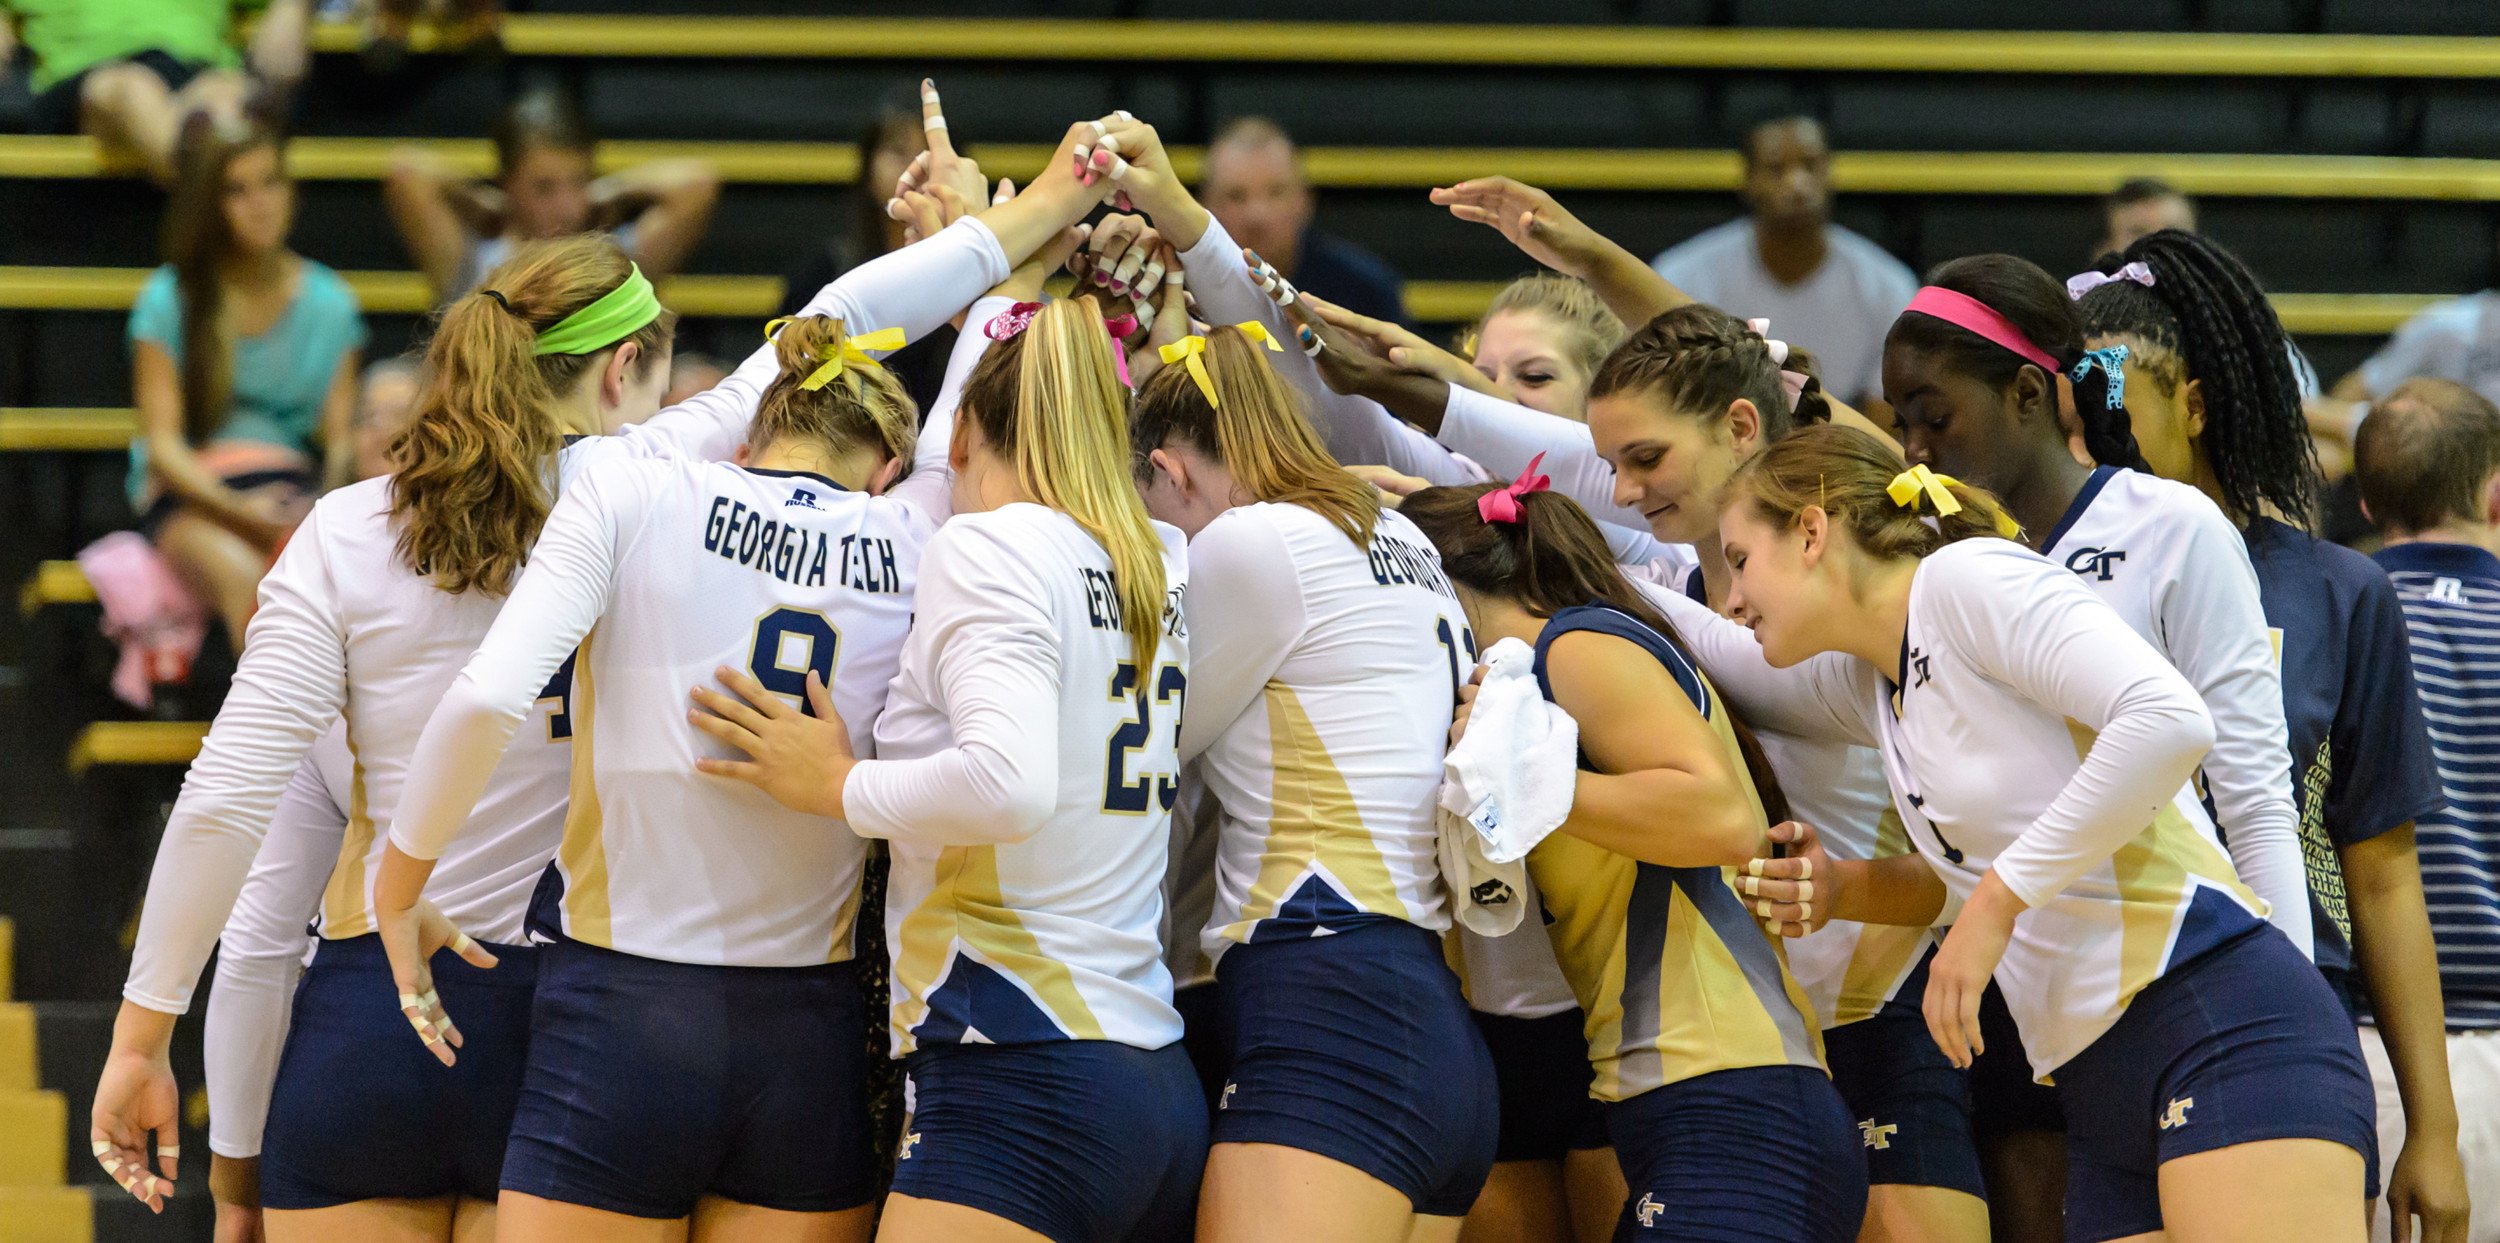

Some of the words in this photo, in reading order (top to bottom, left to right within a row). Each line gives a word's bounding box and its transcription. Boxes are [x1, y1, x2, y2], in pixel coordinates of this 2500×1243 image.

[704, 496, 828, 588] GEORGIA
[840, 532, 900, 594] TECH
[2064, 545, 2127, 582] GT
[745, 602, 842, 718] 9
[1100, 658, 1188, 817] 23
